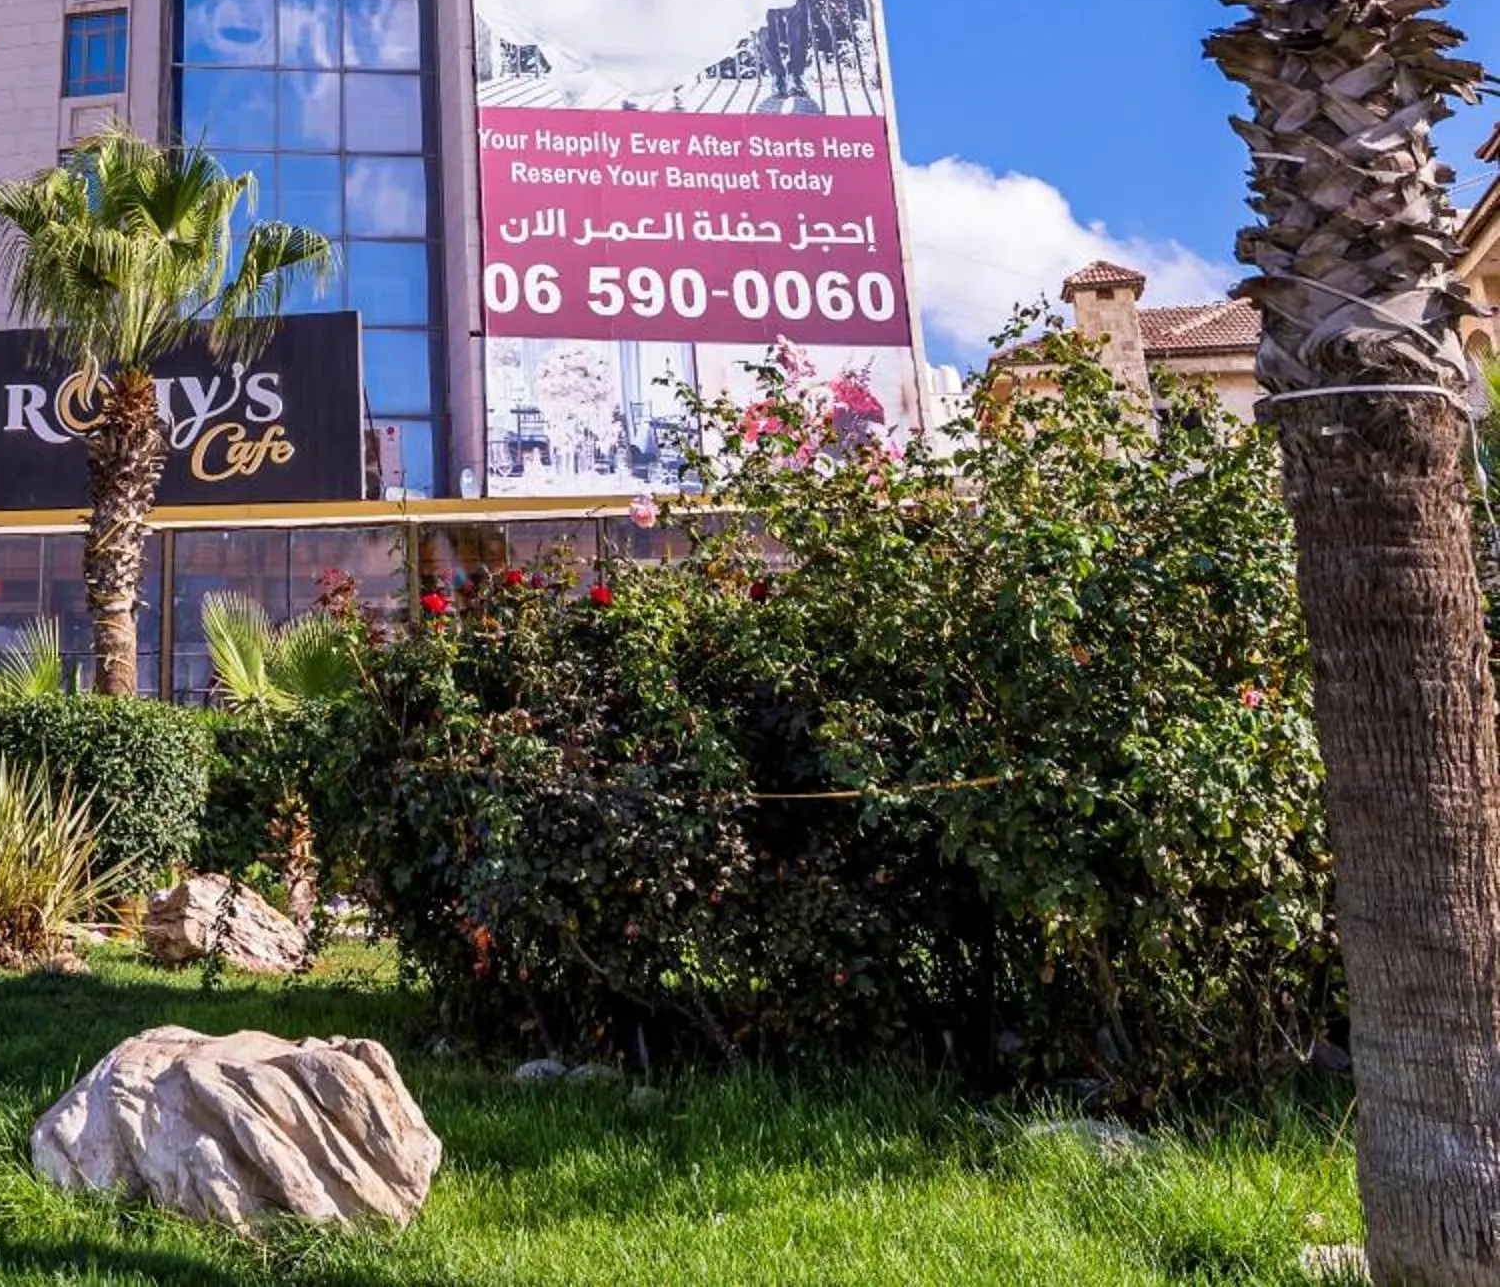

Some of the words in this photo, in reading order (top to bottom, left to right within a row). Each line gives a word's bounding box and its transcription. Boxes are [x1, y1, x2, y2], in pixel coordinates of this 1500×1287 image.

[478, 128, 528, 150] Your
[535, 129, 621, 158] Happily
[630, 133, 681, 154] Ever
[687, 134, 741, 157] After
[749, 136, 816, 158] Starts
[822, 137, 875, 159] Here
[511, 162, 602, 186] Reserve
[607, 164, 658, 187] Your
[666, 166, 760, 194] Banquet
[765, 168, 833, 196] Today
[574, 211, 684, 246] العمر
[692, 211, 781, 244] حفلة
[789, 214, 877, 252] إحجز
[484, 262, 562, 314] 06
[587, 266, 895, 322] 590-0060
[191, 422, 295, 482] Cafe
